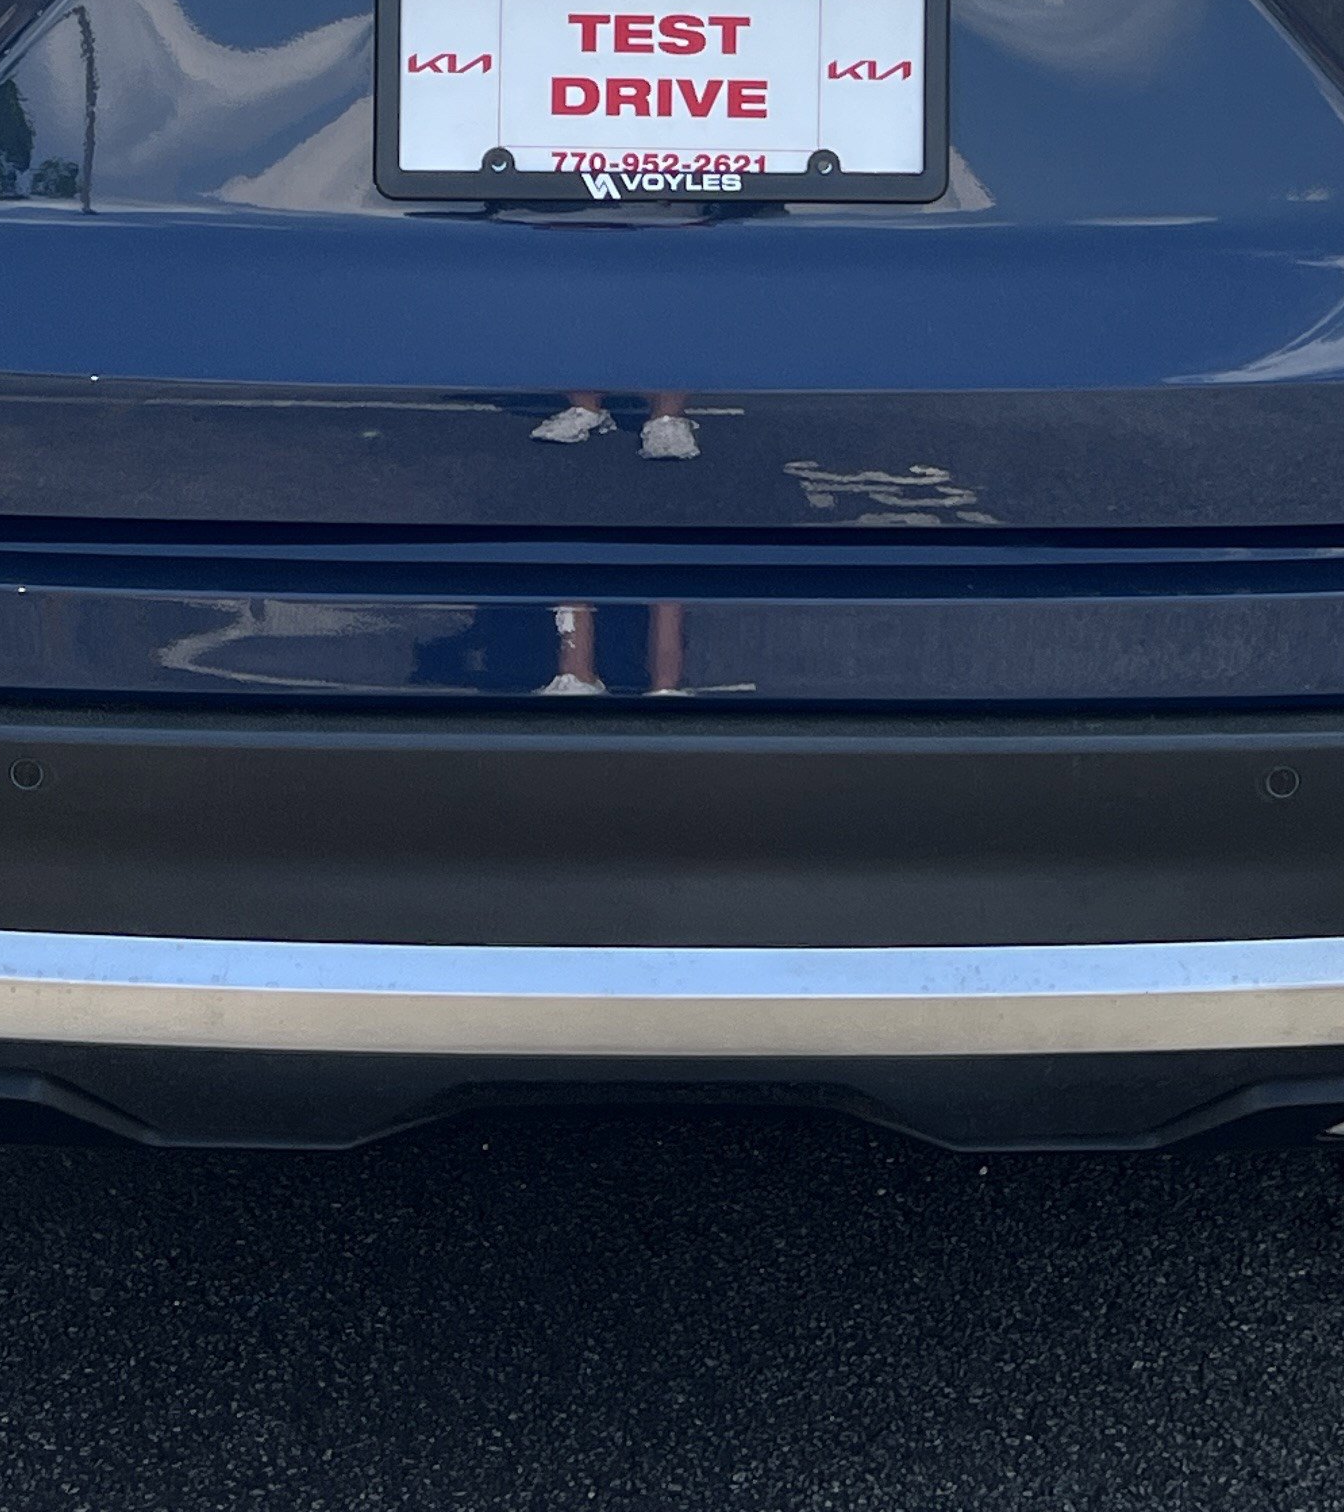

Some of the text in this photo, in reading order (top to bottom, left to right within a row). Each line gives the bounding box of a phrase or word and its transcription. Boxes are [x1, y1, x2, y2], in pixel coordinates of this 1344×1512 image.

[568, 13, 751, 55] TEST
[408, 52, 492, 74] KIA
[827, 59, 912, 82] KIA
[550, 76, 769, 119] DRIVE
[551, 152, 767, 174] 770-952-2621
[620, 173, 743, 192] VOYLES
